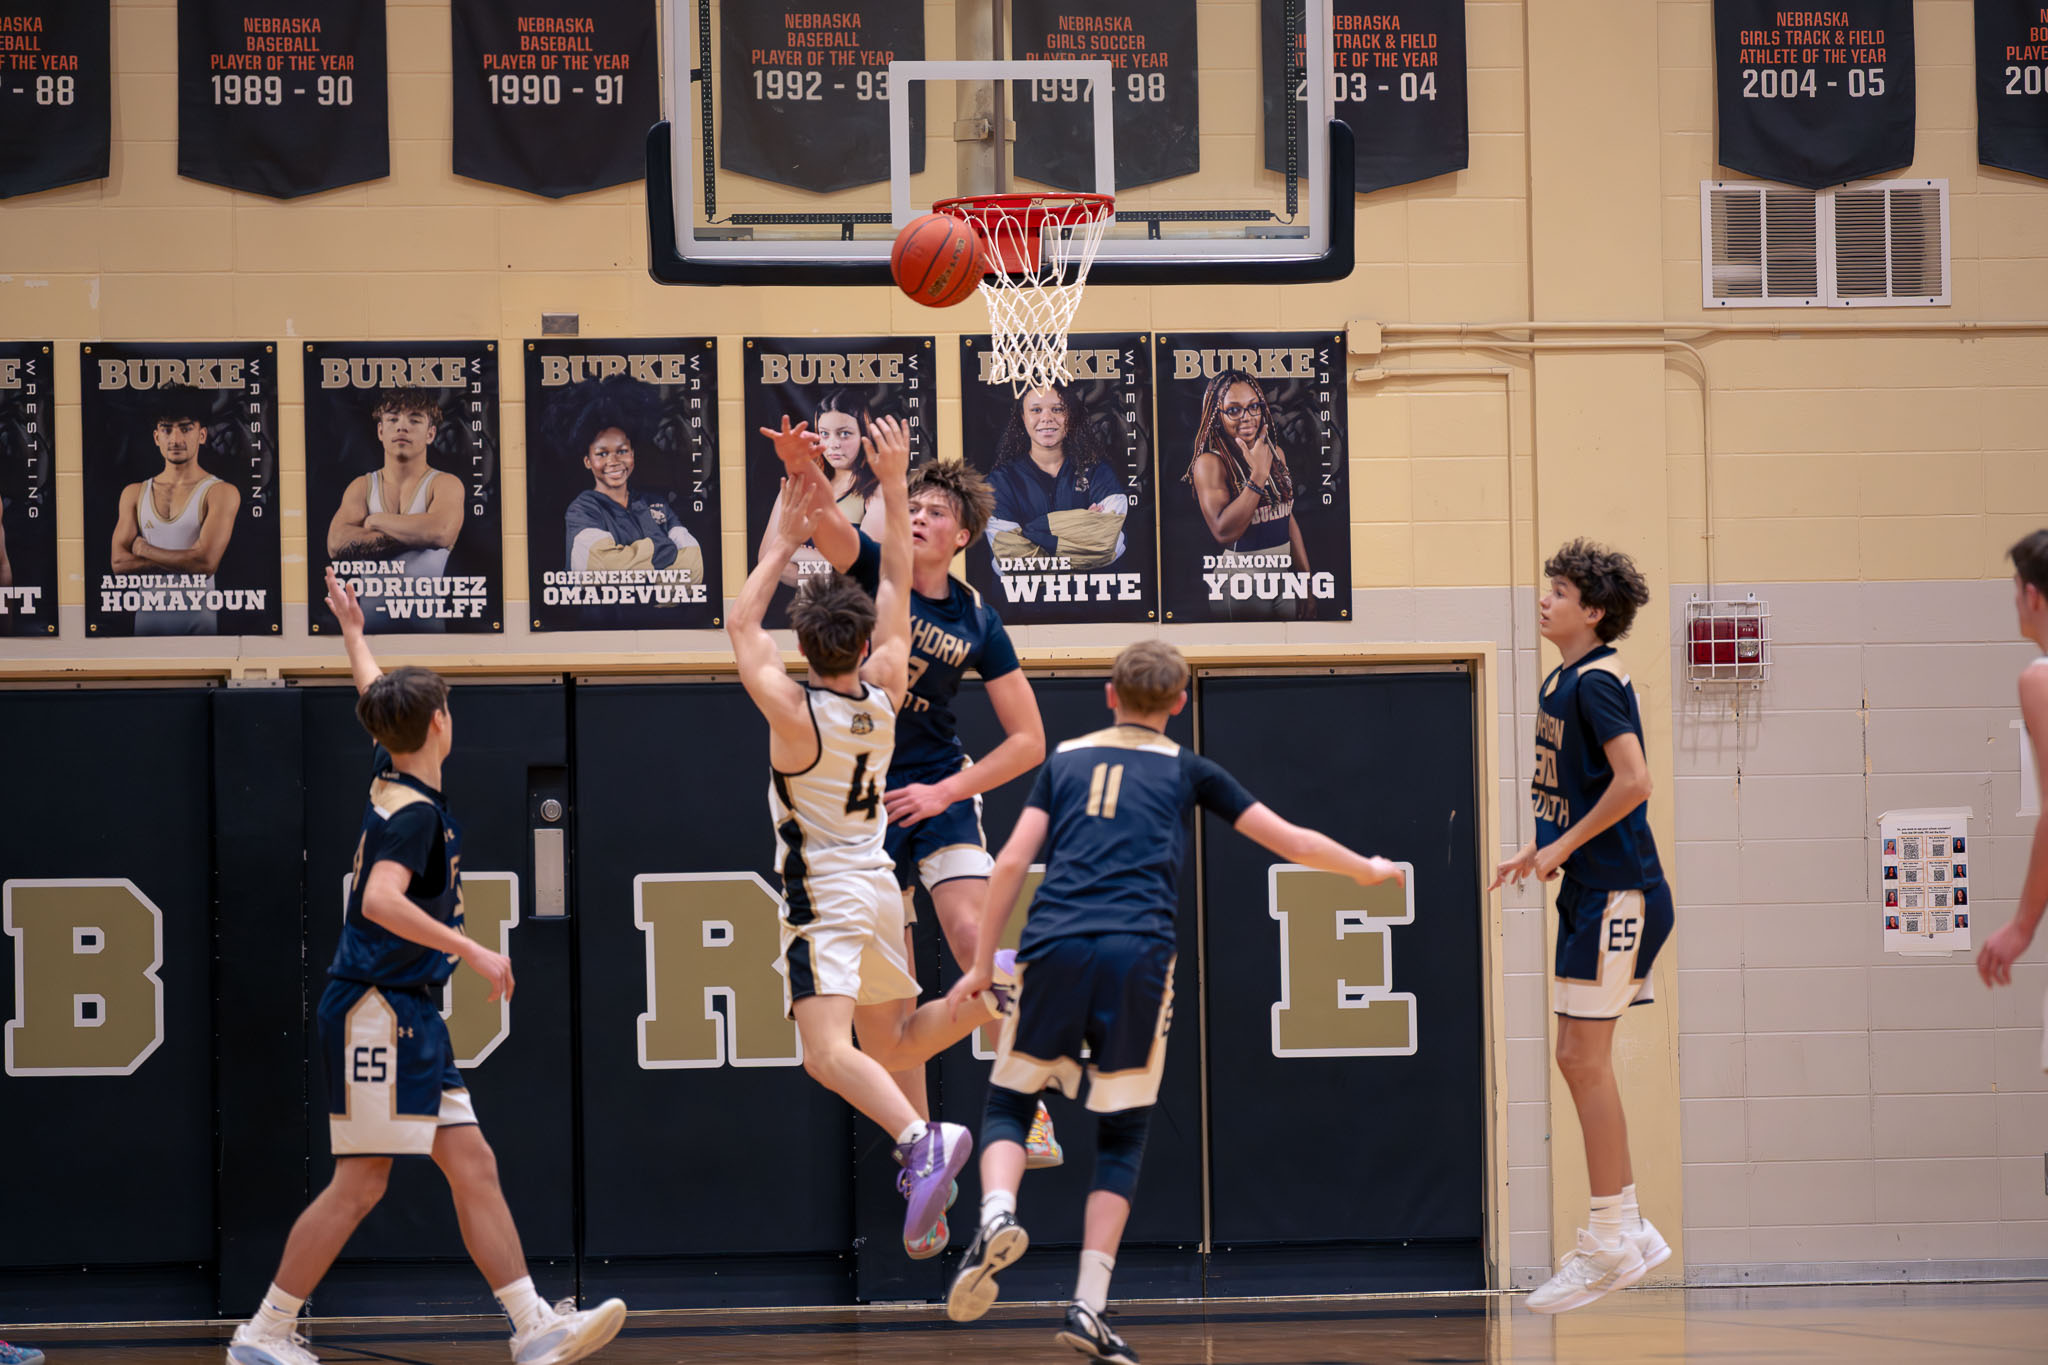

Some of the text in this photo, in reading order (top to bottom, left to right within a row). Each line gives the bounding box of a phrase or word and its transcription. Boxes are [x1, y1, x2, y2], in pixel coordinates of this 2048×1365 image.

[0, 16, 42, 33] ASKA
[244, 17, 321, 33] NEBRASKA
[518, 16, 595, 33] NEBRASKA
[785, 12, 861, 29] NEBRASKA
[1059, 15, 1133, 32] NEBRASKA
[1776, 11, 1849, 27] NEBRASKA
[247, 36, 320, 52] BASEBALL
[521, 35, 593, 52] BASEBALL
[788, 31, 860, 47] BASEBALL
[1047, 33, 1145, 50] GIRLS SOCCER
[1334, 33, 1437, 49] TRACK & FIELD
[1740, 29, 1885, 46] GIRLS TRACK & FIELD
[9, 54, 37, 70] THE
[41, 55, 78, 70] YEAR
[210, 54, 354, 70] PLAYER OF THE YEAR
[483, 54, 630, 70] PLAYER OF THE YEAR
[751, 49, 894, 66] PLAYER OF THE YEAR
[1132, 53, 1168, 68] YEAR
[1352, 52, 1369, 68] OF
[1373, 52, 1399, 68] THE
[1402, 52, 1438, 67] YEAR
[1739, 48, 1887, 64] ATHLETE OF THE YEAR
[36, 75, 74, 105] 88
[212, 75, 282, 105] 1989
[317, 75, 353, 106] 90
[488, 75, 561, 105] 1990
[595, 75, 624, 105] 91
[753, 70, 823, 100] 1992
[856, 70, 889, 101] 93
[1127, 73, 1165, 102] 98
[1296, 71, 1367, 102] 203
[1400, 72, 1437, 102] 04
[1742, 69, 1817, 98] 2004
[1848, 68, 1885, 98] 05
[2005, 65, 2048, 95] 20
[98, 358, 245, 390] BURKE
[320, 357, 467, 389] BURKE
[541, 354, 686, 386] BURKE
[760, 354, 904, 385] BURKE
[1173, 348, 1315, 380] BURKE
[26, 359, 39, 518] WRESTLING
[250, 359, 263, 518] WRESTLING
[470, 358, 484, 516] WRESTLING
[690, 355, 703, 512] WRESTLING
[1124, 350, 1138, 506] WRESTLING
[1319, 349, 1332, 505] WRESTLING
[331, 560, 406, 575] JORDAN
[1000, 556, 1071, 572] DAYVIE
[1203, 555, 1292, 569] DIAMOND
[101, 574, 207, 589] ABDULLAH
[543, 569, 691, 585] OGHENEKEVWE
[1000, 573, 1142, 603] WHITE
[1203, 571, 1335, 600] YOUNG
[101, 589, 266, 612] HOMAYOUN
[543, 585, 707, 605] OMADEVUAE
[910, 615, 972, 668] HORN
[845, 752, 879, 821] 4
[1086, 763, 1124, 819] 11
[1608, 919, 1638, 952] ES
[353, 1047, 387, 1082] ES
